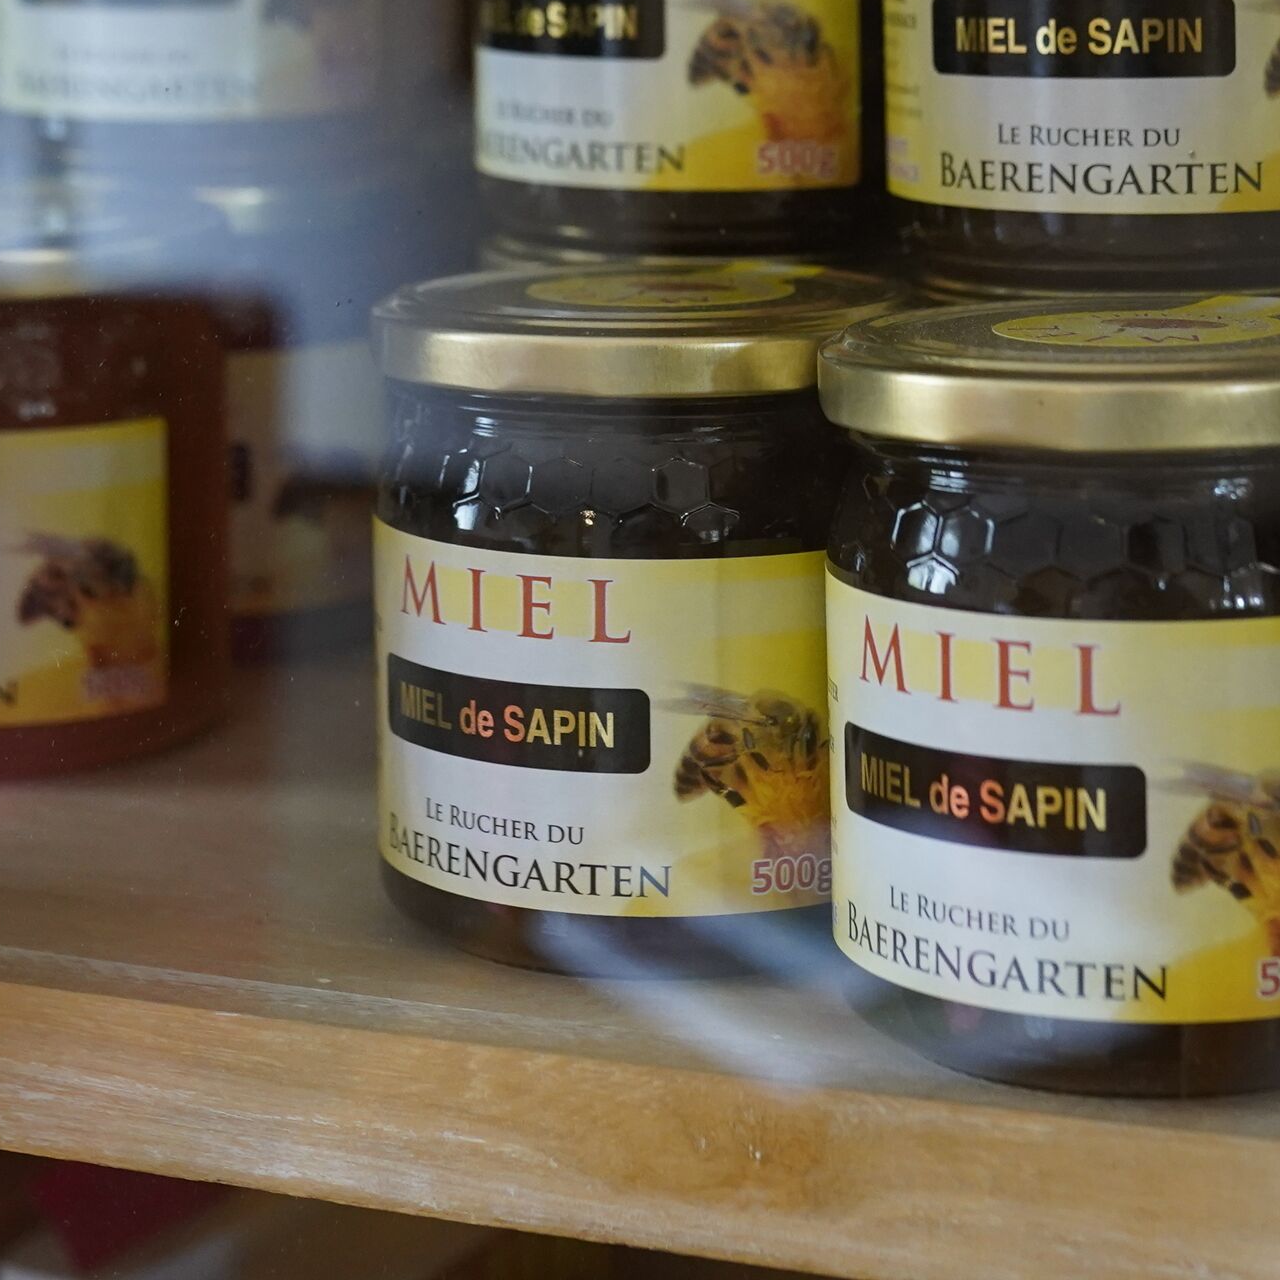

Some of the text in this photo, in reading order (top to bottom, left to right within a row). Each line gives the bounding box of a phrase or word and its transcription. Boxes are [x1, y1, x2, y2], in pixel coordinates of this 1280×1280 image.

[955, 17, 1203, 56] MIEL de SAPIN
[997, 123, 1181, 148] LE RUCHER DU
[940, 152, 1263, 196] BAERENGARTEN
[400, 554, 632, 644] MIEL
[859, 614, 1121, 717] MIEL
[399, 681, 615, 749] MIEL de SAPIN
[425, 796, 585, 846] LE RUCHER DU
[861, 752, 1107, 832] MIEL de SAPIN
[389, 811, 672, 899] BAERENGARTEN
[751, 853, 832, 895] 500g
[889, 884, 1070, 942] LE RUCHER DU
[847, 900, 1169, 1002] BAERENGARTEN
